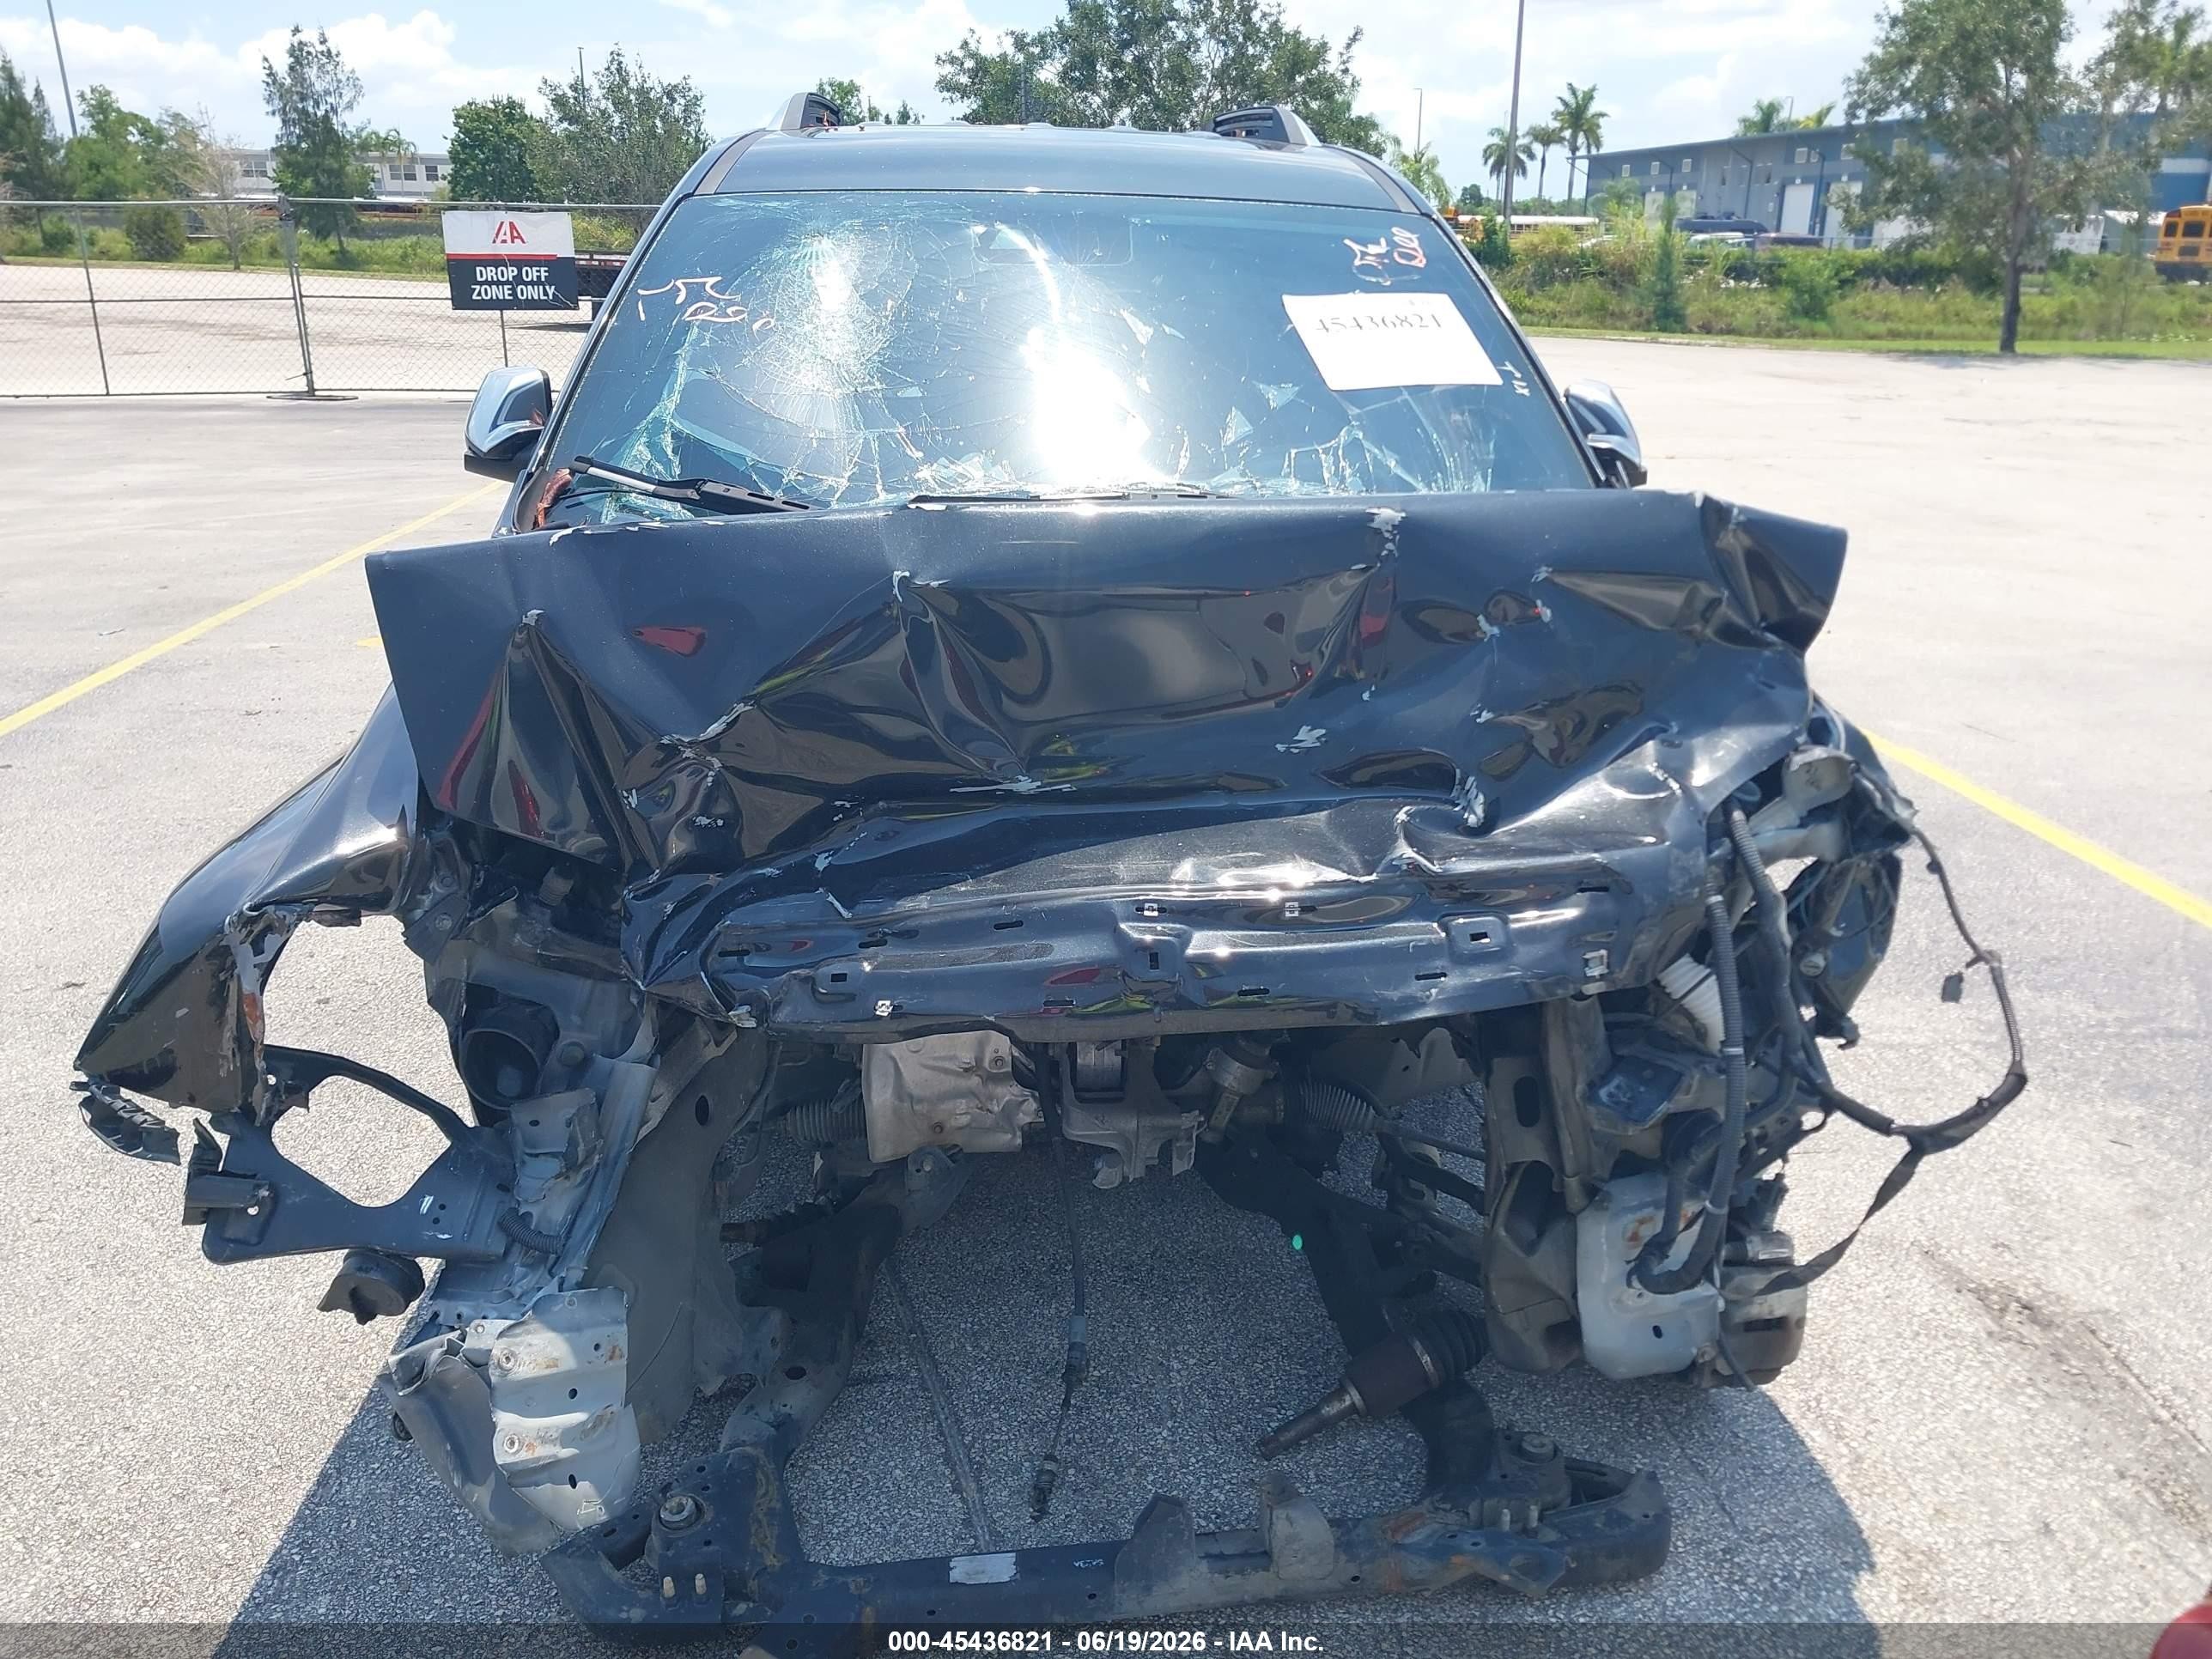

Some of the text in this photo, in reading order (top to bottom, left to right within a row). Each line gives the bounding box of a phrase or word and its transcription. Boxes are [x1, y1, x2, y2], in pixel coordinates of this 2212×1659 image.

[476, 266, 550, 282] DROP OFF
[471, 284, 556, 301] ZONE ONLY
